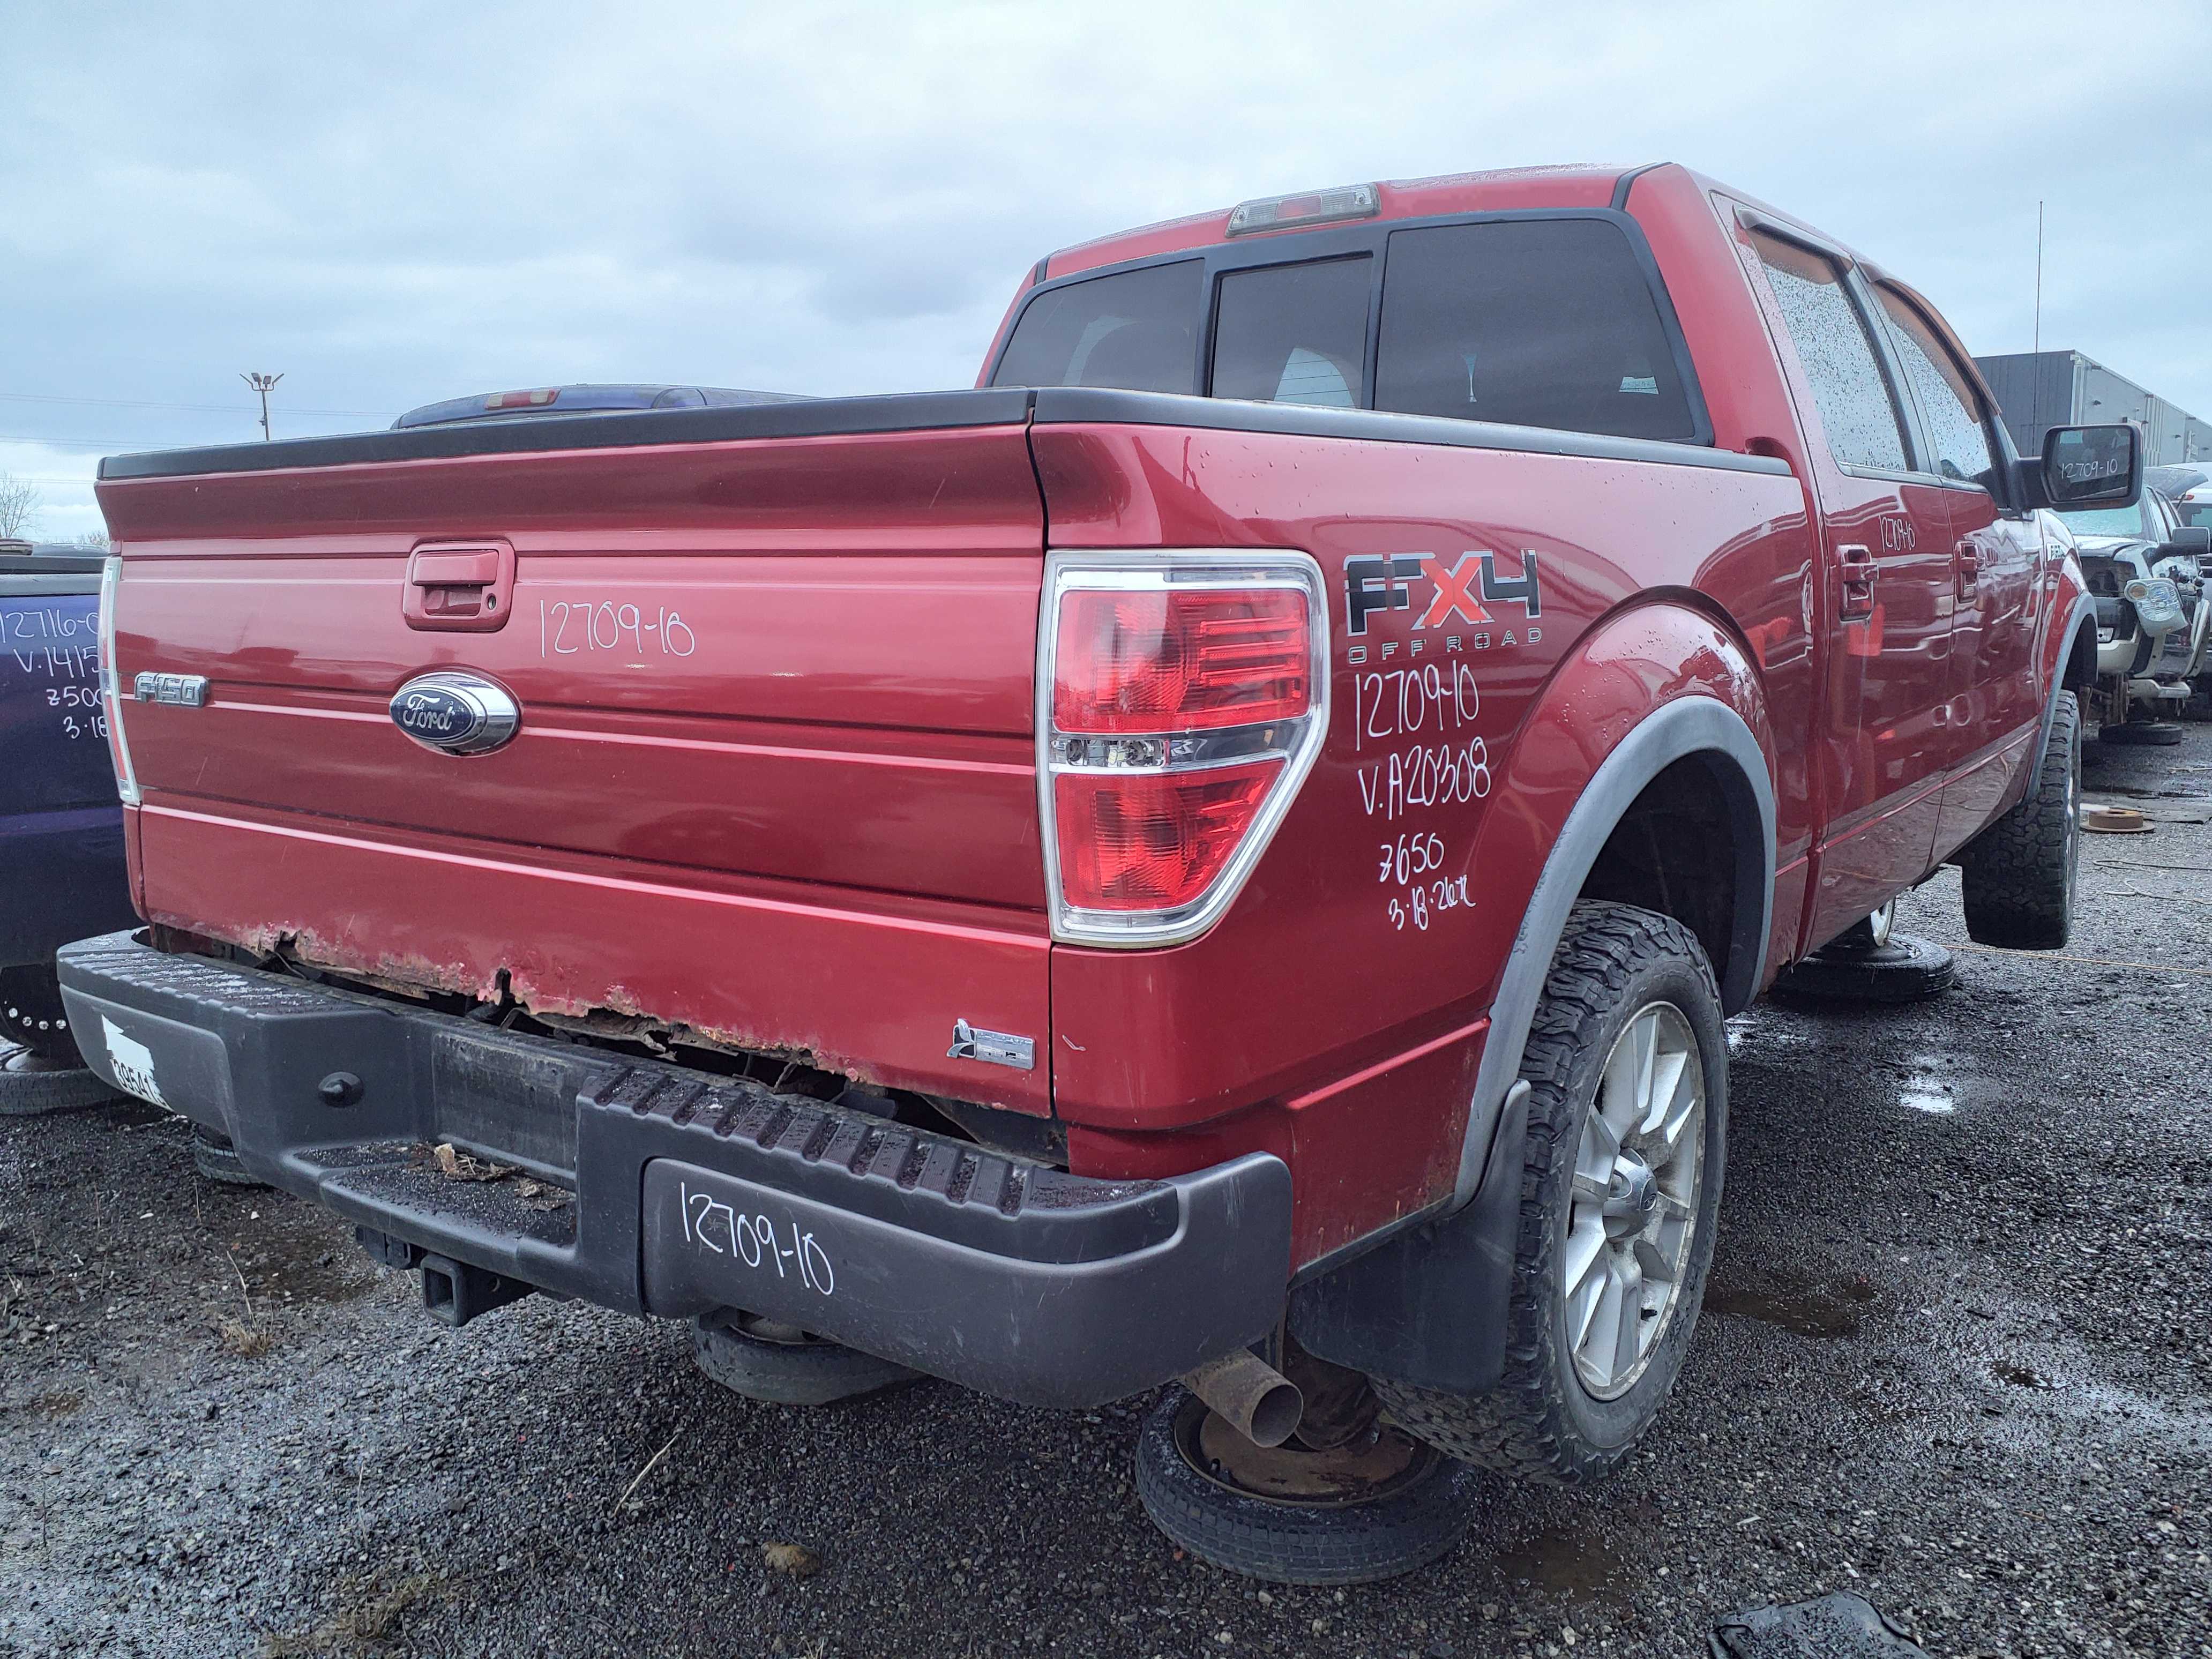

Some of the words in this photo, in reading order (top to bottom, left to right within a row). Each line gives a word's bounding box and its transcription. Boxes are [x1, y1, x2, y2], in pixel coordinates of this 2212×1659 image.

[2061, 458, 2118, 480] 12709-10
[1343, 548, 1542, 637] FX4
[403, 693, 454, 731] Ford
[1355, 660, 1479, 751] 12709-10
[681, 1181, 834, 1295] 12709-10
